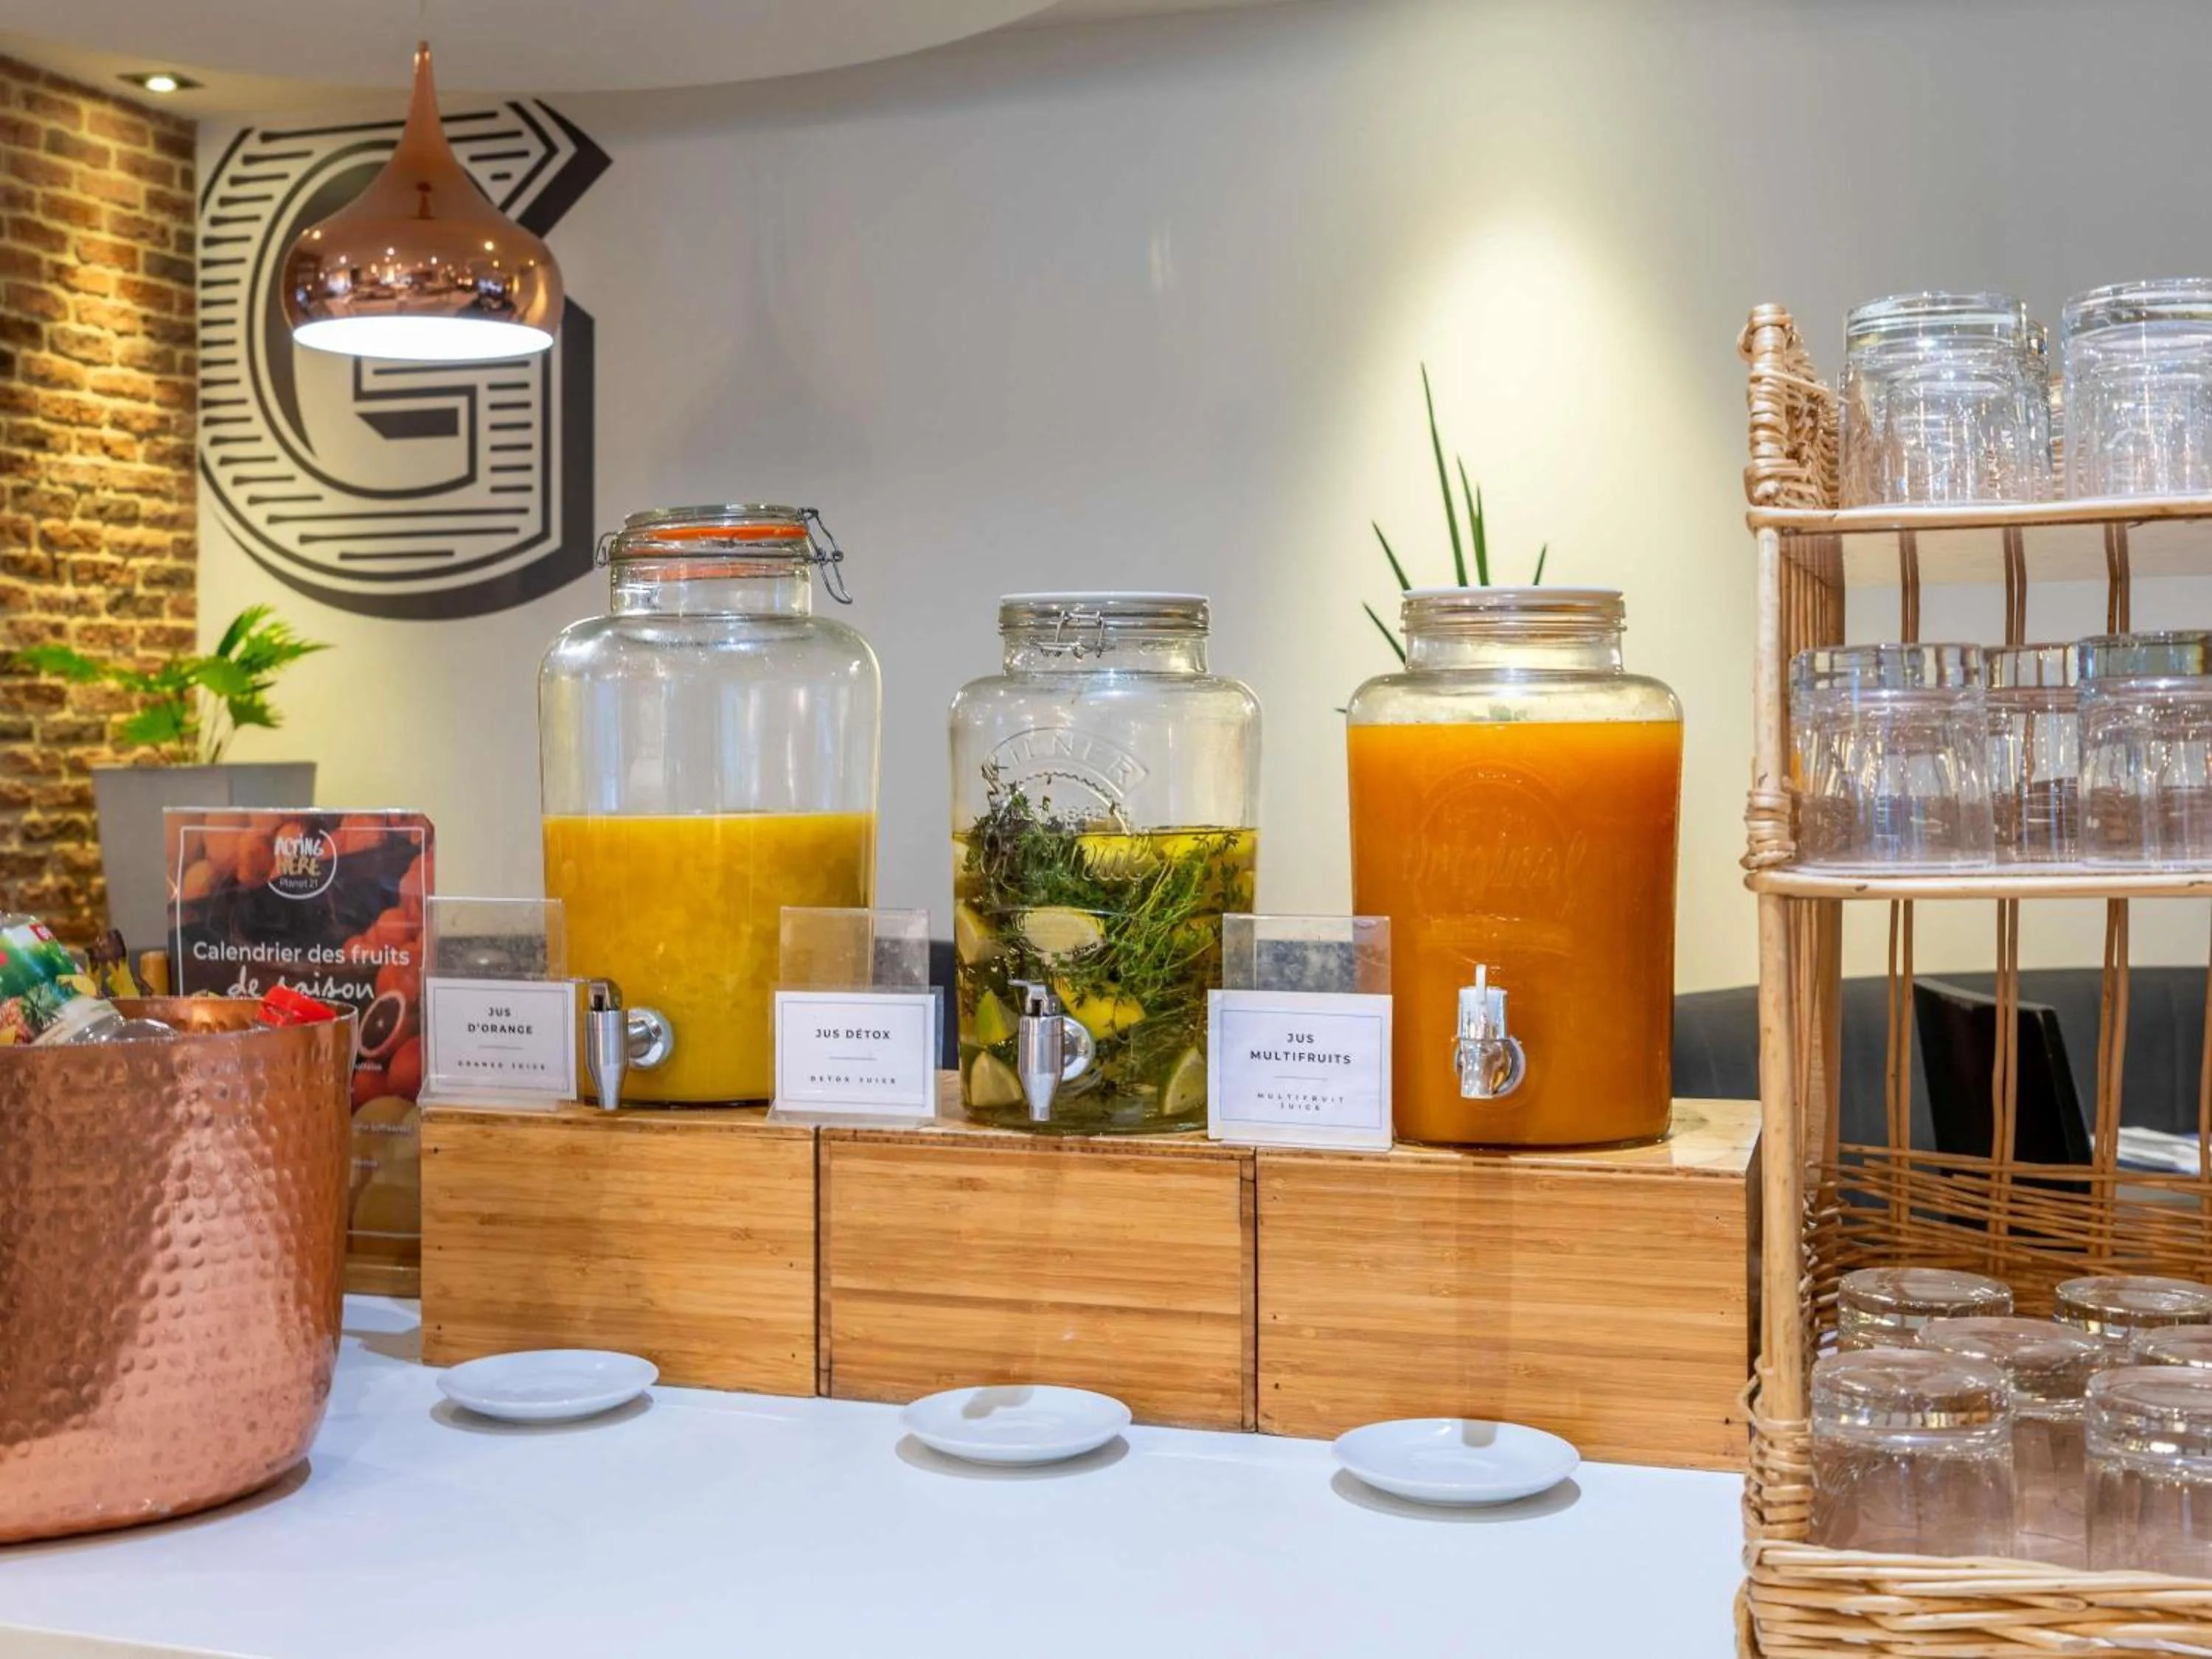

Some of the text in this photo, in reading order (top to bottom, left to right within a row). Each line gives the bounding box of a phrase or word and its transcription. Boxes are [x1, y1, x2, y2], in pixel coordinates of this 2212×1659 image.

[985, 734, 1133, 794] ILNER
[274, 832, 324, 856] ACTING
[277, 855, 322, 877] HERE
[193, 941, 410, 966] Calendrier des fruits
[226, 964, 261, 997] de
[487, 1006, 511, 1018] JUS
[467, 1022, 533, 1034] D'ORANGE
[815, 1027, 891, 1040] JUS DÉTOX
[1287, 1032, 1315, 1044] JUS
[1250, 1050, 1352, 1065] MULTIFRUITS
[1257, 1092, 1343, 1105] MULTIFRUIT
